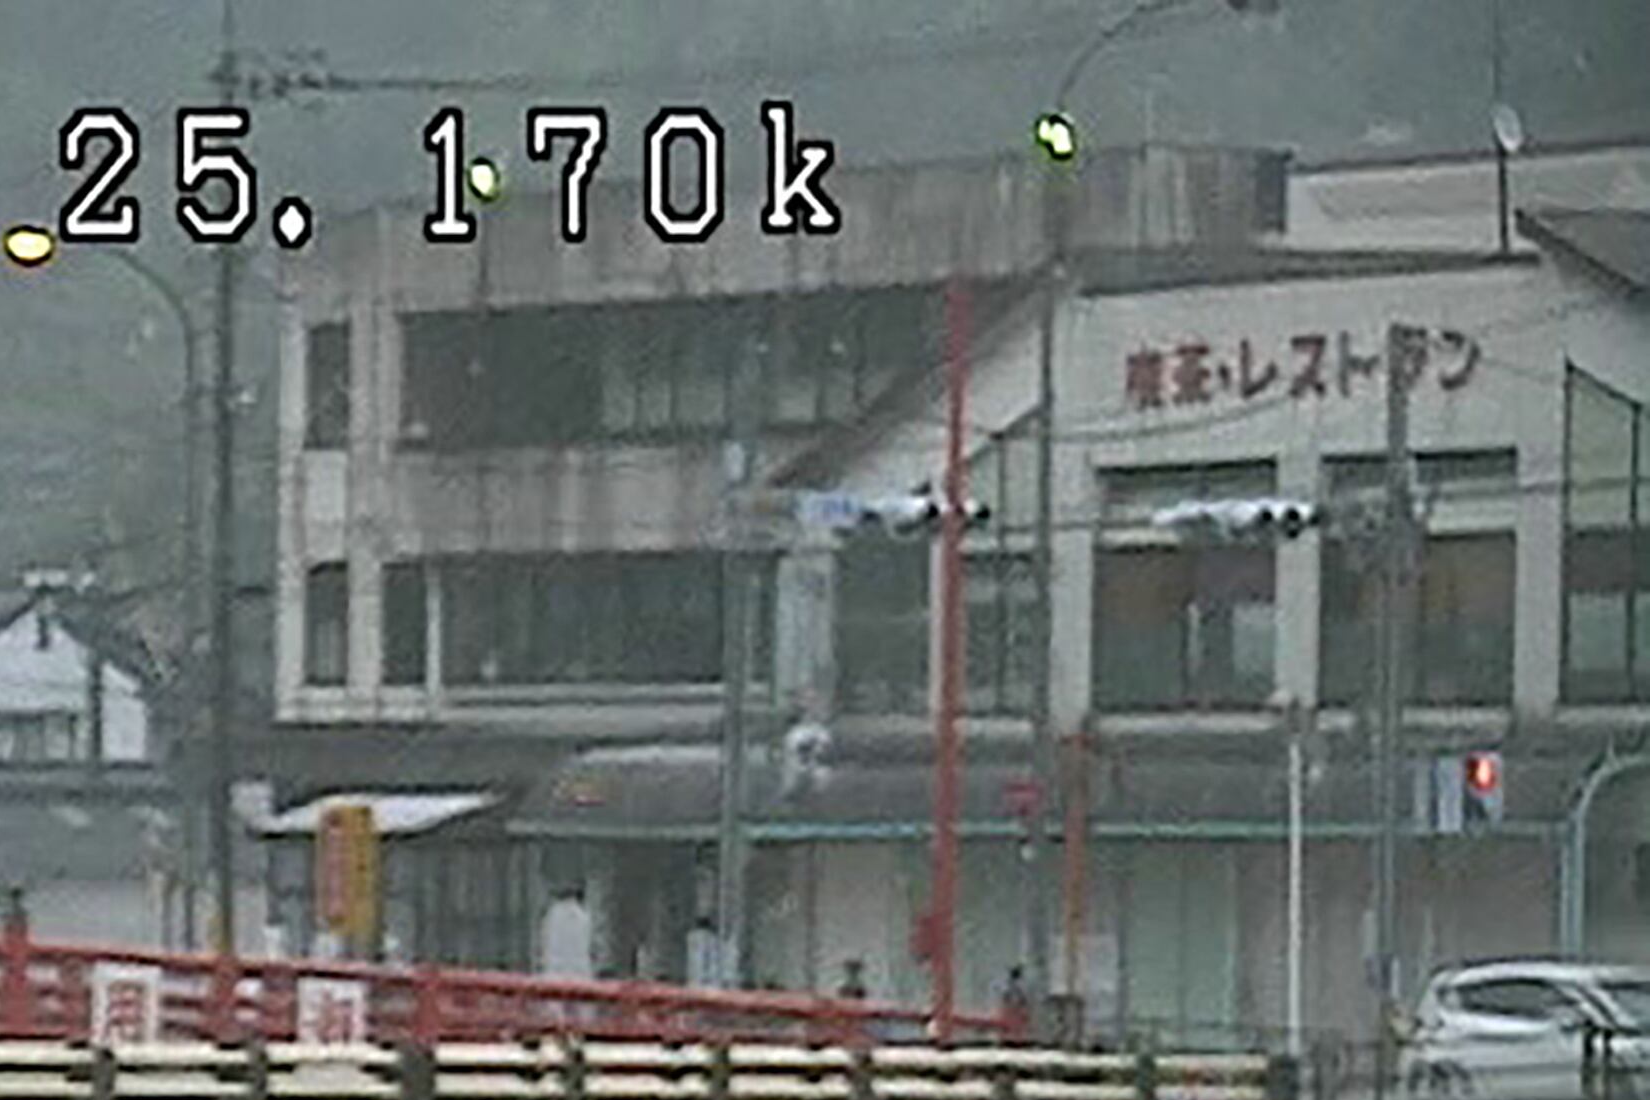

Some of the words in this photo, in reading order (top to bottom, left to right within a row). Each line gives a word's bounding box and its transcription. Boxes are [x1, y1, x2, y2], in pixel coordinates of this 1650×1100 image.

[1124, 324, 1482, 408] 茶・レストラン
